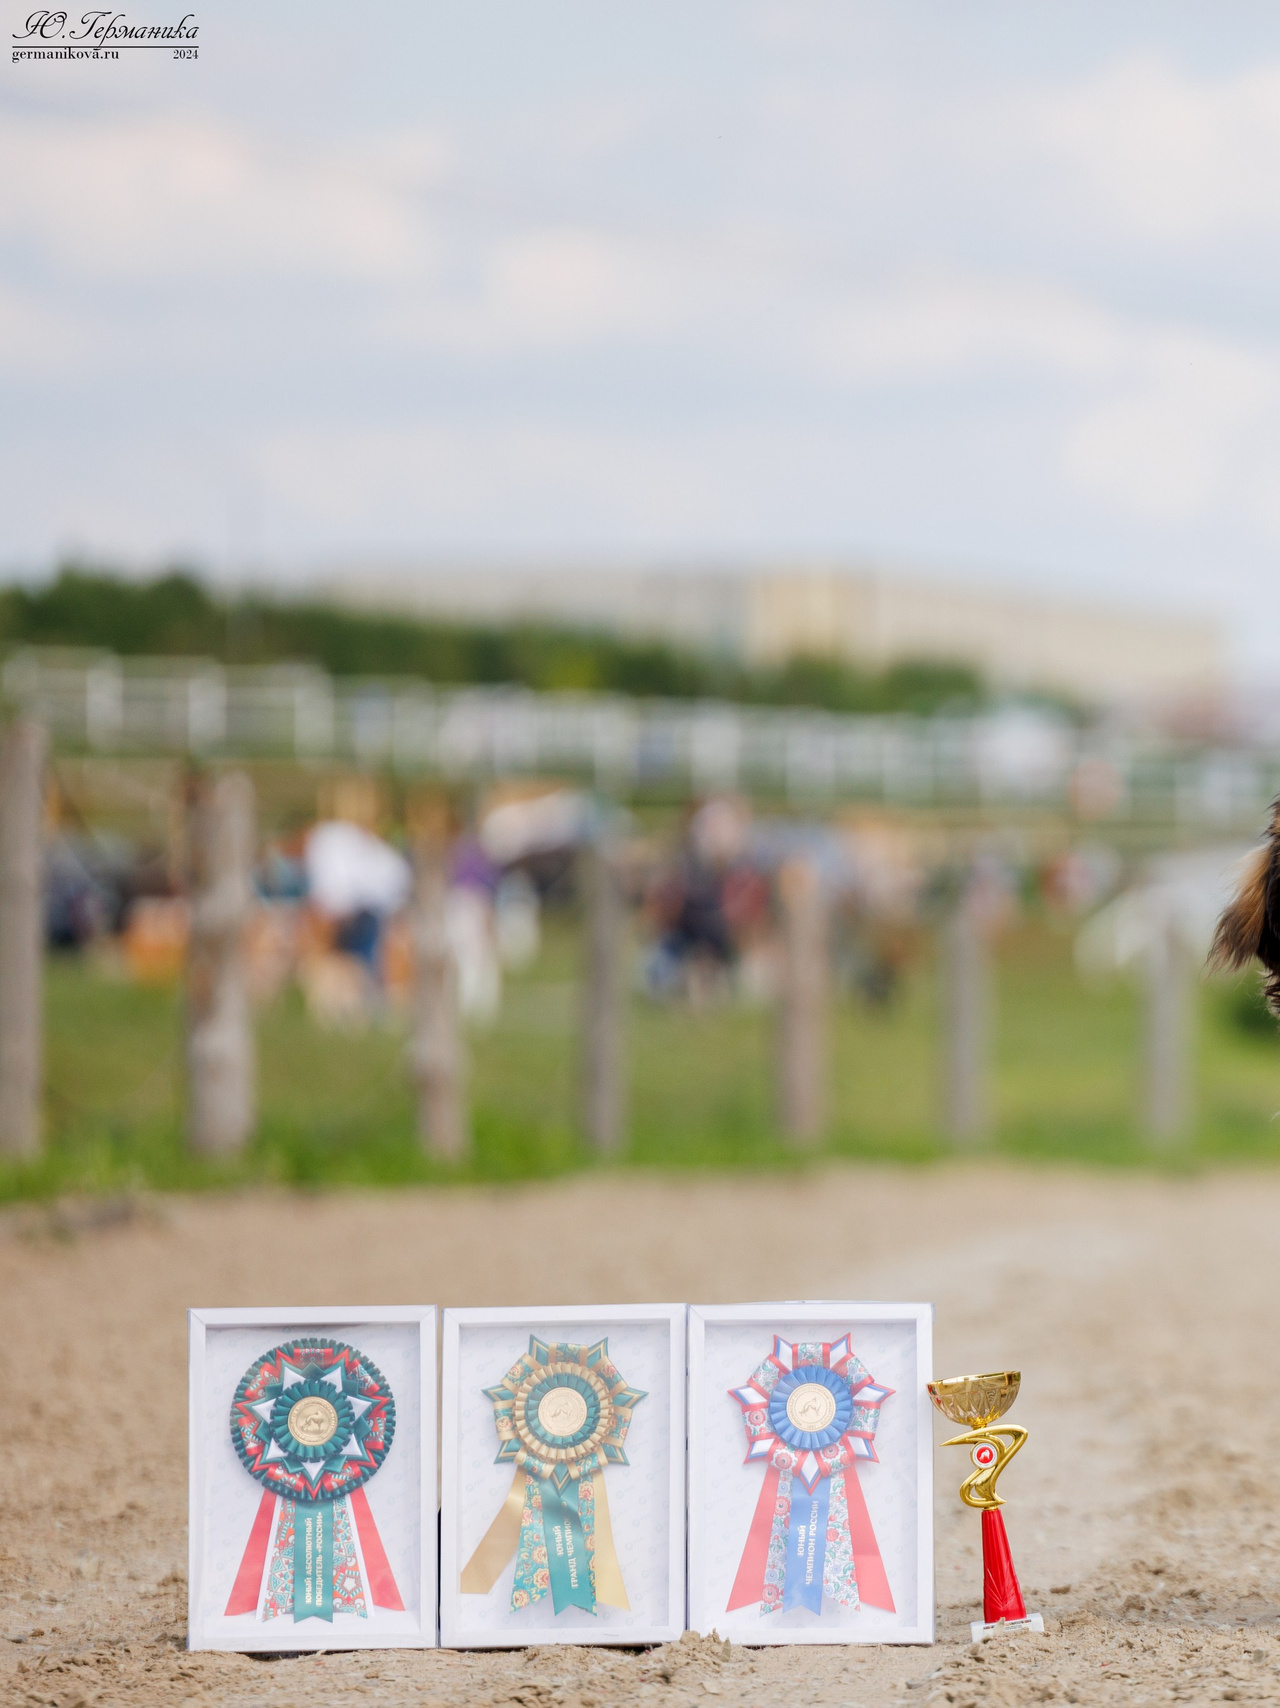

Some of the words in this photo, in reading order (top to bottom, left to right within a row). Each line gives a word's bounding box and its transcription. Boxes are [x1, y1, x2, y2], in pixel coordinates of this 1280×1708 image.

[809, 1500, 819, 1536] РОССИИ
[552, 1525, 563, 1556] ЮНЫЙ
[563, 1518, 575, 1557] ЧЕМПИО
[797, 1525, 807, 1556] ЮНЫЙ
[568, 1557, 579, 1589] ГРАНД
[806, 1538, 816, 1585] ЧЕМПИОН
[315, 1554, 323, 1607] ПОБЕДИТЕЛЬ
